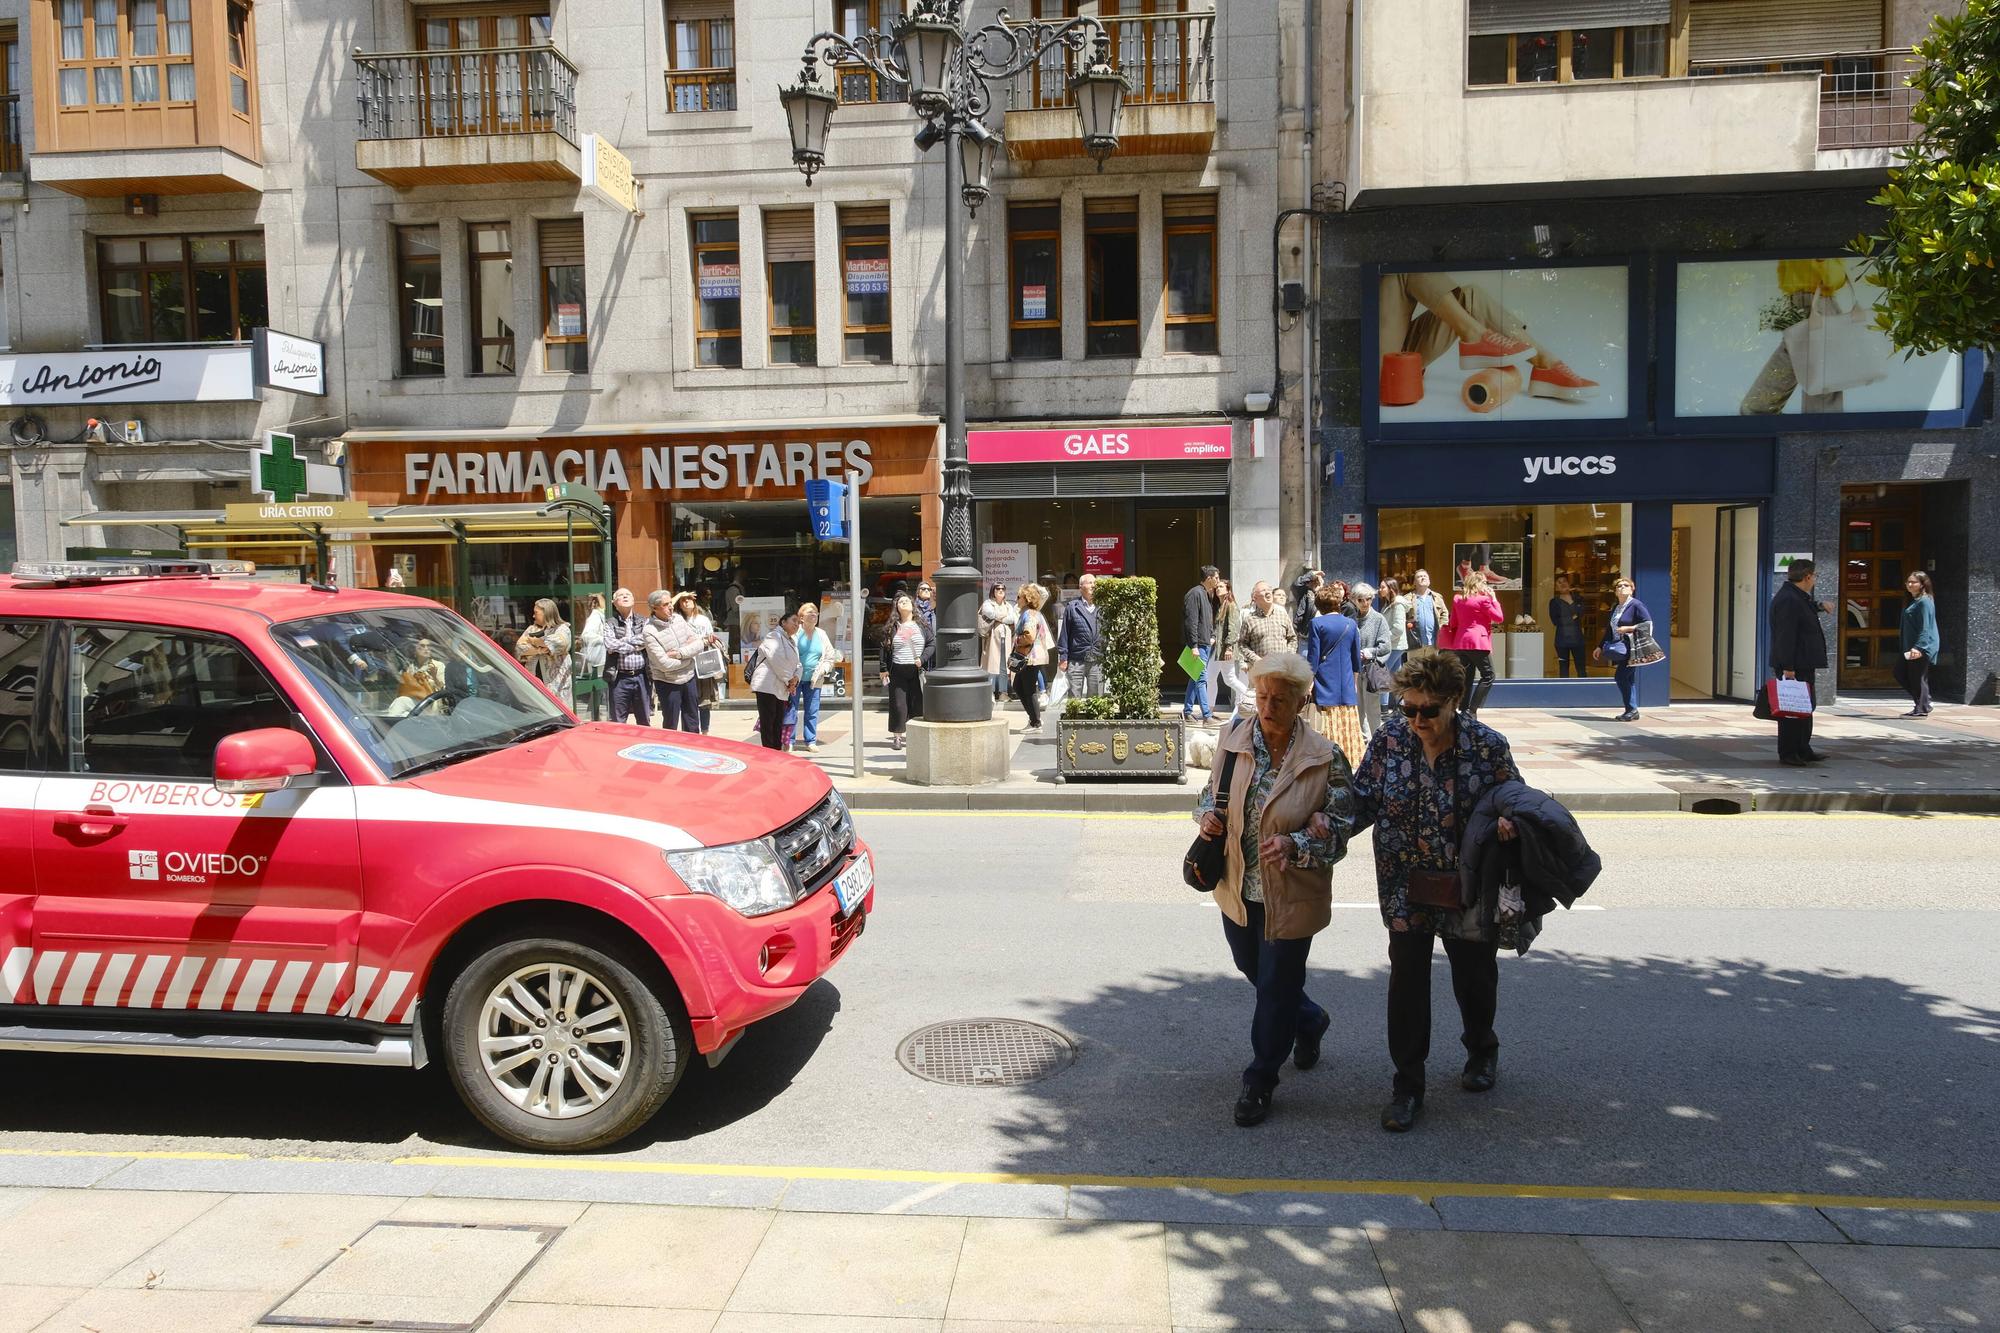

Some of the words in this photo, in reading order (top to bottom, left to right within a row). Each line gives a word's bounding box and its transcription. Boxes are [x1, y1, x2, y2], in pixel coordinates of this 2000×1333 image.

[712, 288, 722, 297] 20
[860, 283, 870, 292] 20
[872, 283, 881, 291] 53
[22, 354, 161, 394] Antonio
[273, 359, 318, 374] Antonio
[1063, 433, 1130, 455] GAES
[1184, 444, 1225, 455] amplifon
[405, 449, 629, 495] FARMACIA
[641, 440, 874, 490] NESTARES
[1523, 455, 1617, 483] yuccs
[259, 505, 287, 518] URÍA
[288, 505, 334, 518] CENTRO
[819, 521, 830, 536] 22
[90, 782, 237, 808] BOMBEROS
[166, 874, 206, 882] BOMBEROS
